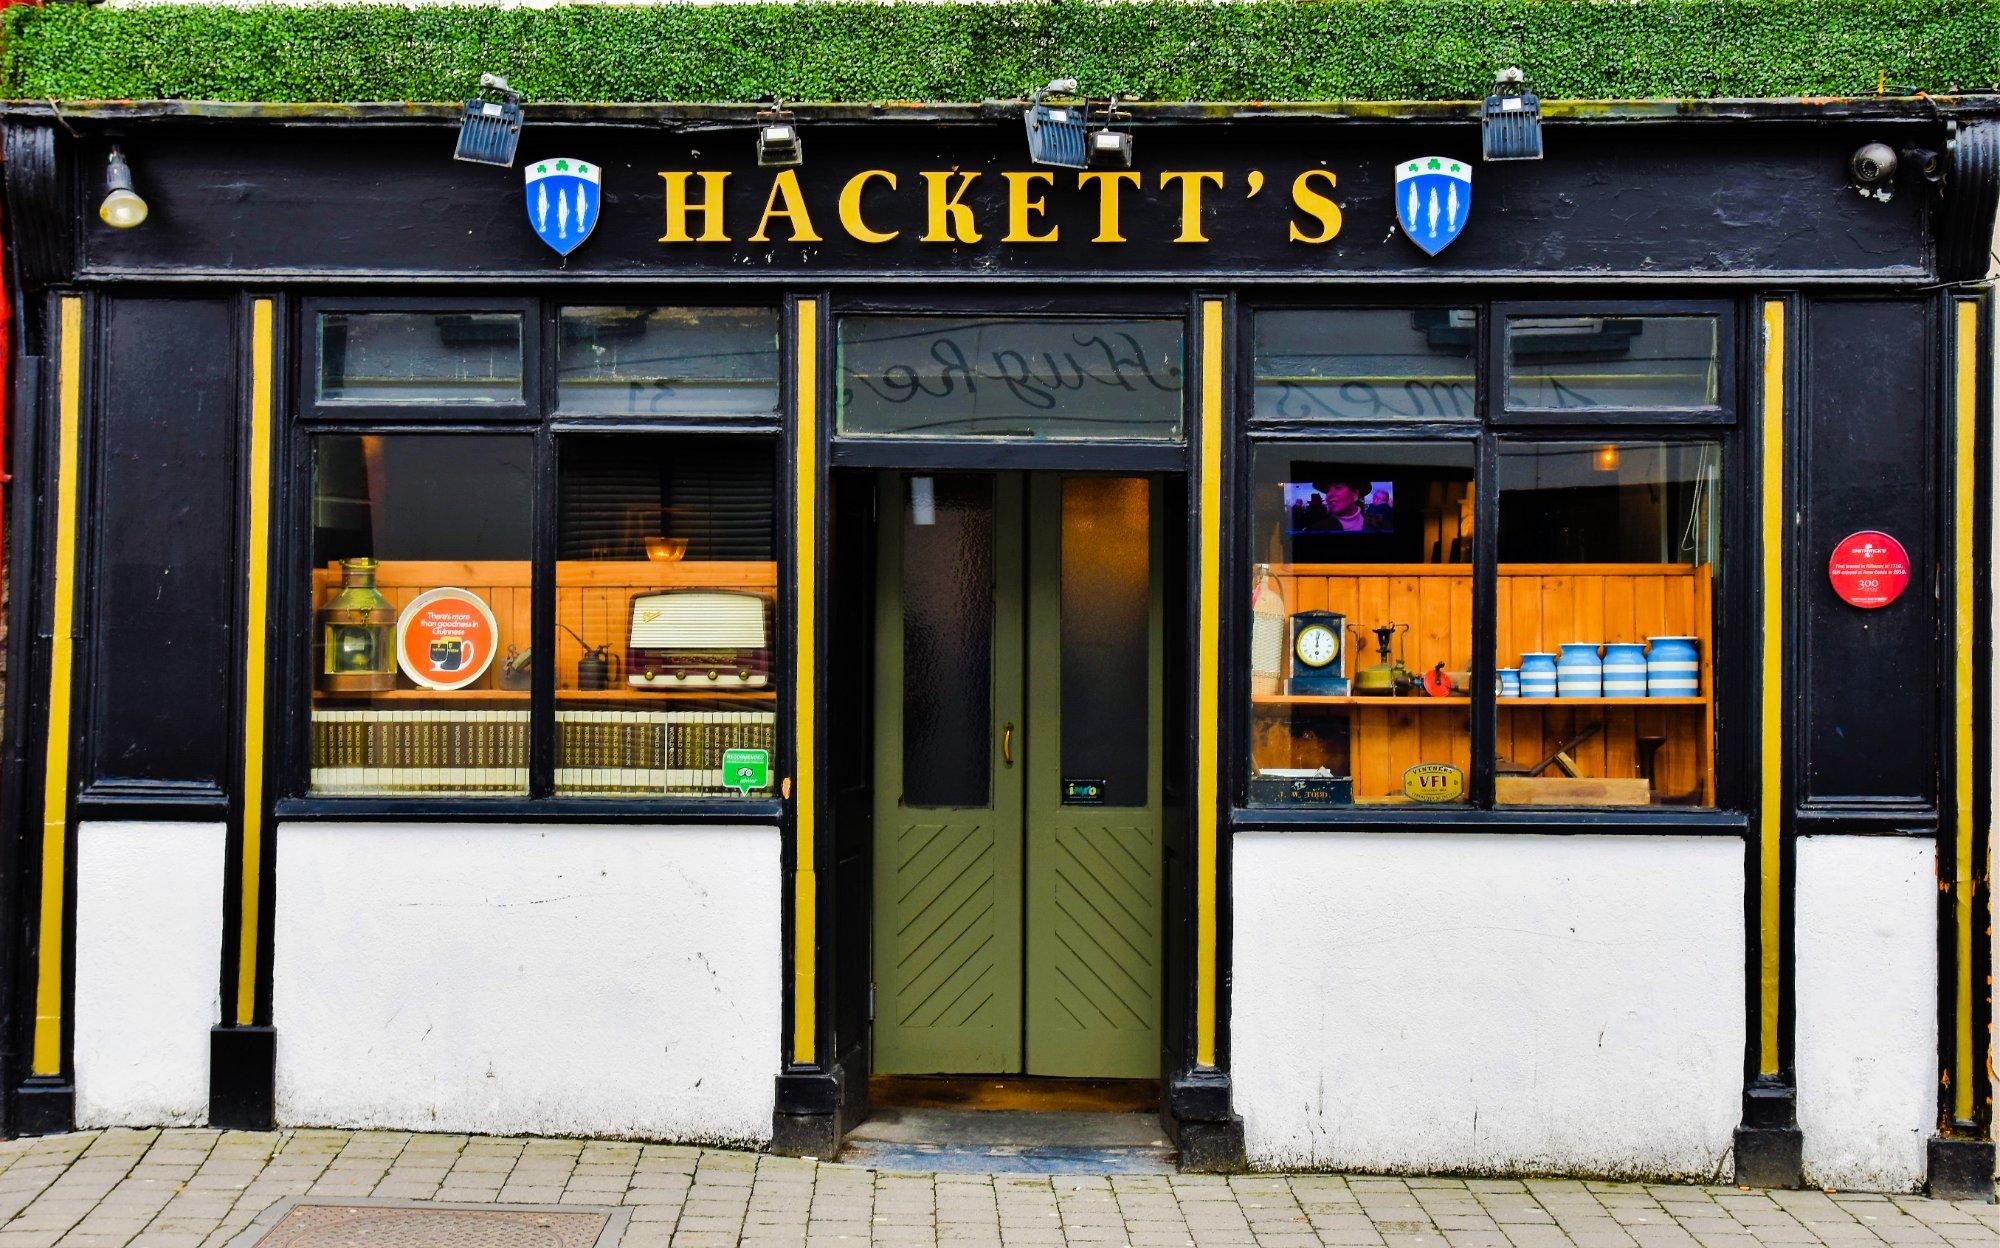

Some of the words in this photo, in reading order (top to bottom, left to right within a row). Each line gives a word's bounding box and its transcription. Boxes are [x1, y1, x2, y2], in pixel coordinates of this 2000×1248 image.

[657, 169, 1343, 244] HACKETT'S
[1858, 579, 1879, 590] 300
[420, 620, 437, 628] than
[432, 627, 465, 636] Guinness
[1419, 775, 1447, 787] VFI
